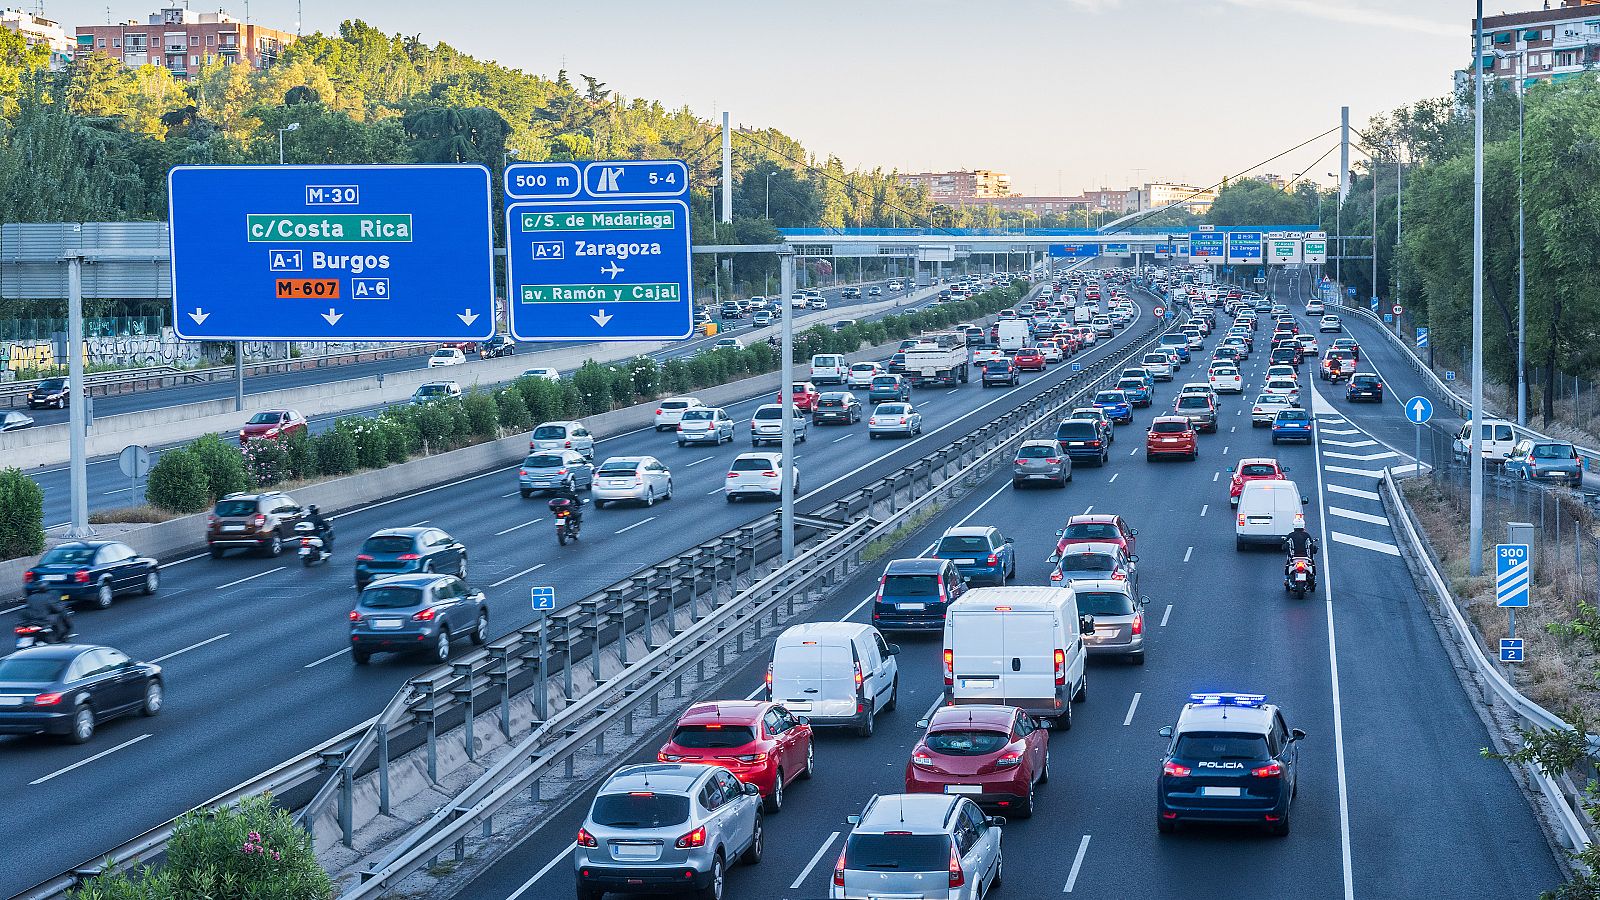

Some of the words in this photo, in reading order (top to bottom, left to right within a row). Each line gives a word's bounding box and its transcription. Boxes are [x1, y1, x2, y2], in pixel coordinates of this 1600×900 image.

[516, 175, 547, 187] 500
[556, 176, 569, 187] m
[649, 173, 676, 185] 5-4
[309, 188, 356, 203] M-30
[524, 215, 560, 228] c/S.
[565, 214, 585, 227] de
[592, 213, 672, 228] Madariaga
[251, 219, 345, 238] c/Costa
[360, 219, 409, 238] Rica
[536, 244, 561, 257] A-2
[575, 240, 662, 259] Zaragoza
[273, 253, 300, 268] A-1
[312, 252, 390, 273] Burgos
[278, 282, 337, 296] M-607
[355, 281, 386, 296] A-6
[525, 290, 547, 300] av.
[552, 286, 606, 300] Ramón
[614, 291, 623, 302] y
[632, 285, 677, 301] Cajal
[1500, 548, 1524, 558] 300
[1508, 558, 1518, 566] m
[539, 597, 548, 607] 2
[1507, 650, 1516, 659] 2
